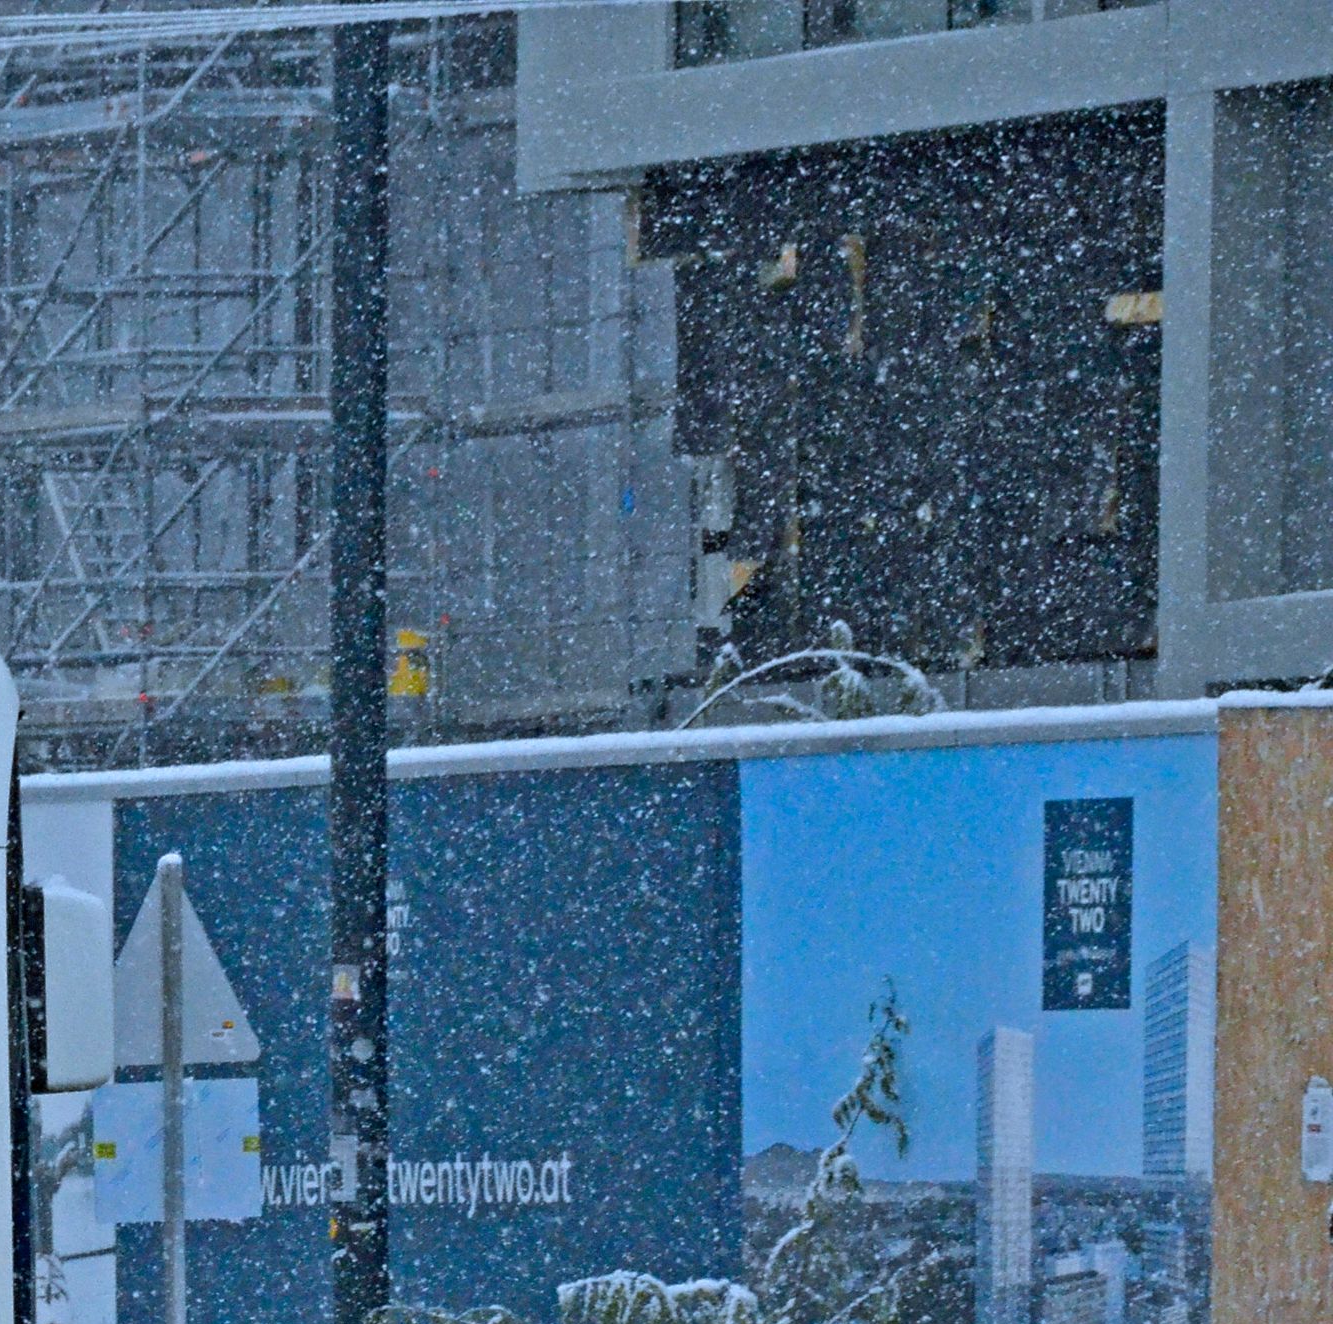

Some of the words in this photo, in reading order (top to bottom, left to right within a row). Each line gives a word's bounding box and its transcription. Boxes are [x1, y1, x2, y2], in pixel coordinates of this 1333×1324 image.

[1061, 849, 1116, 874] VIENNA
[1056, 876, 1119, 904] TWENTY
[1069, 905, 1106, 933] TWO
